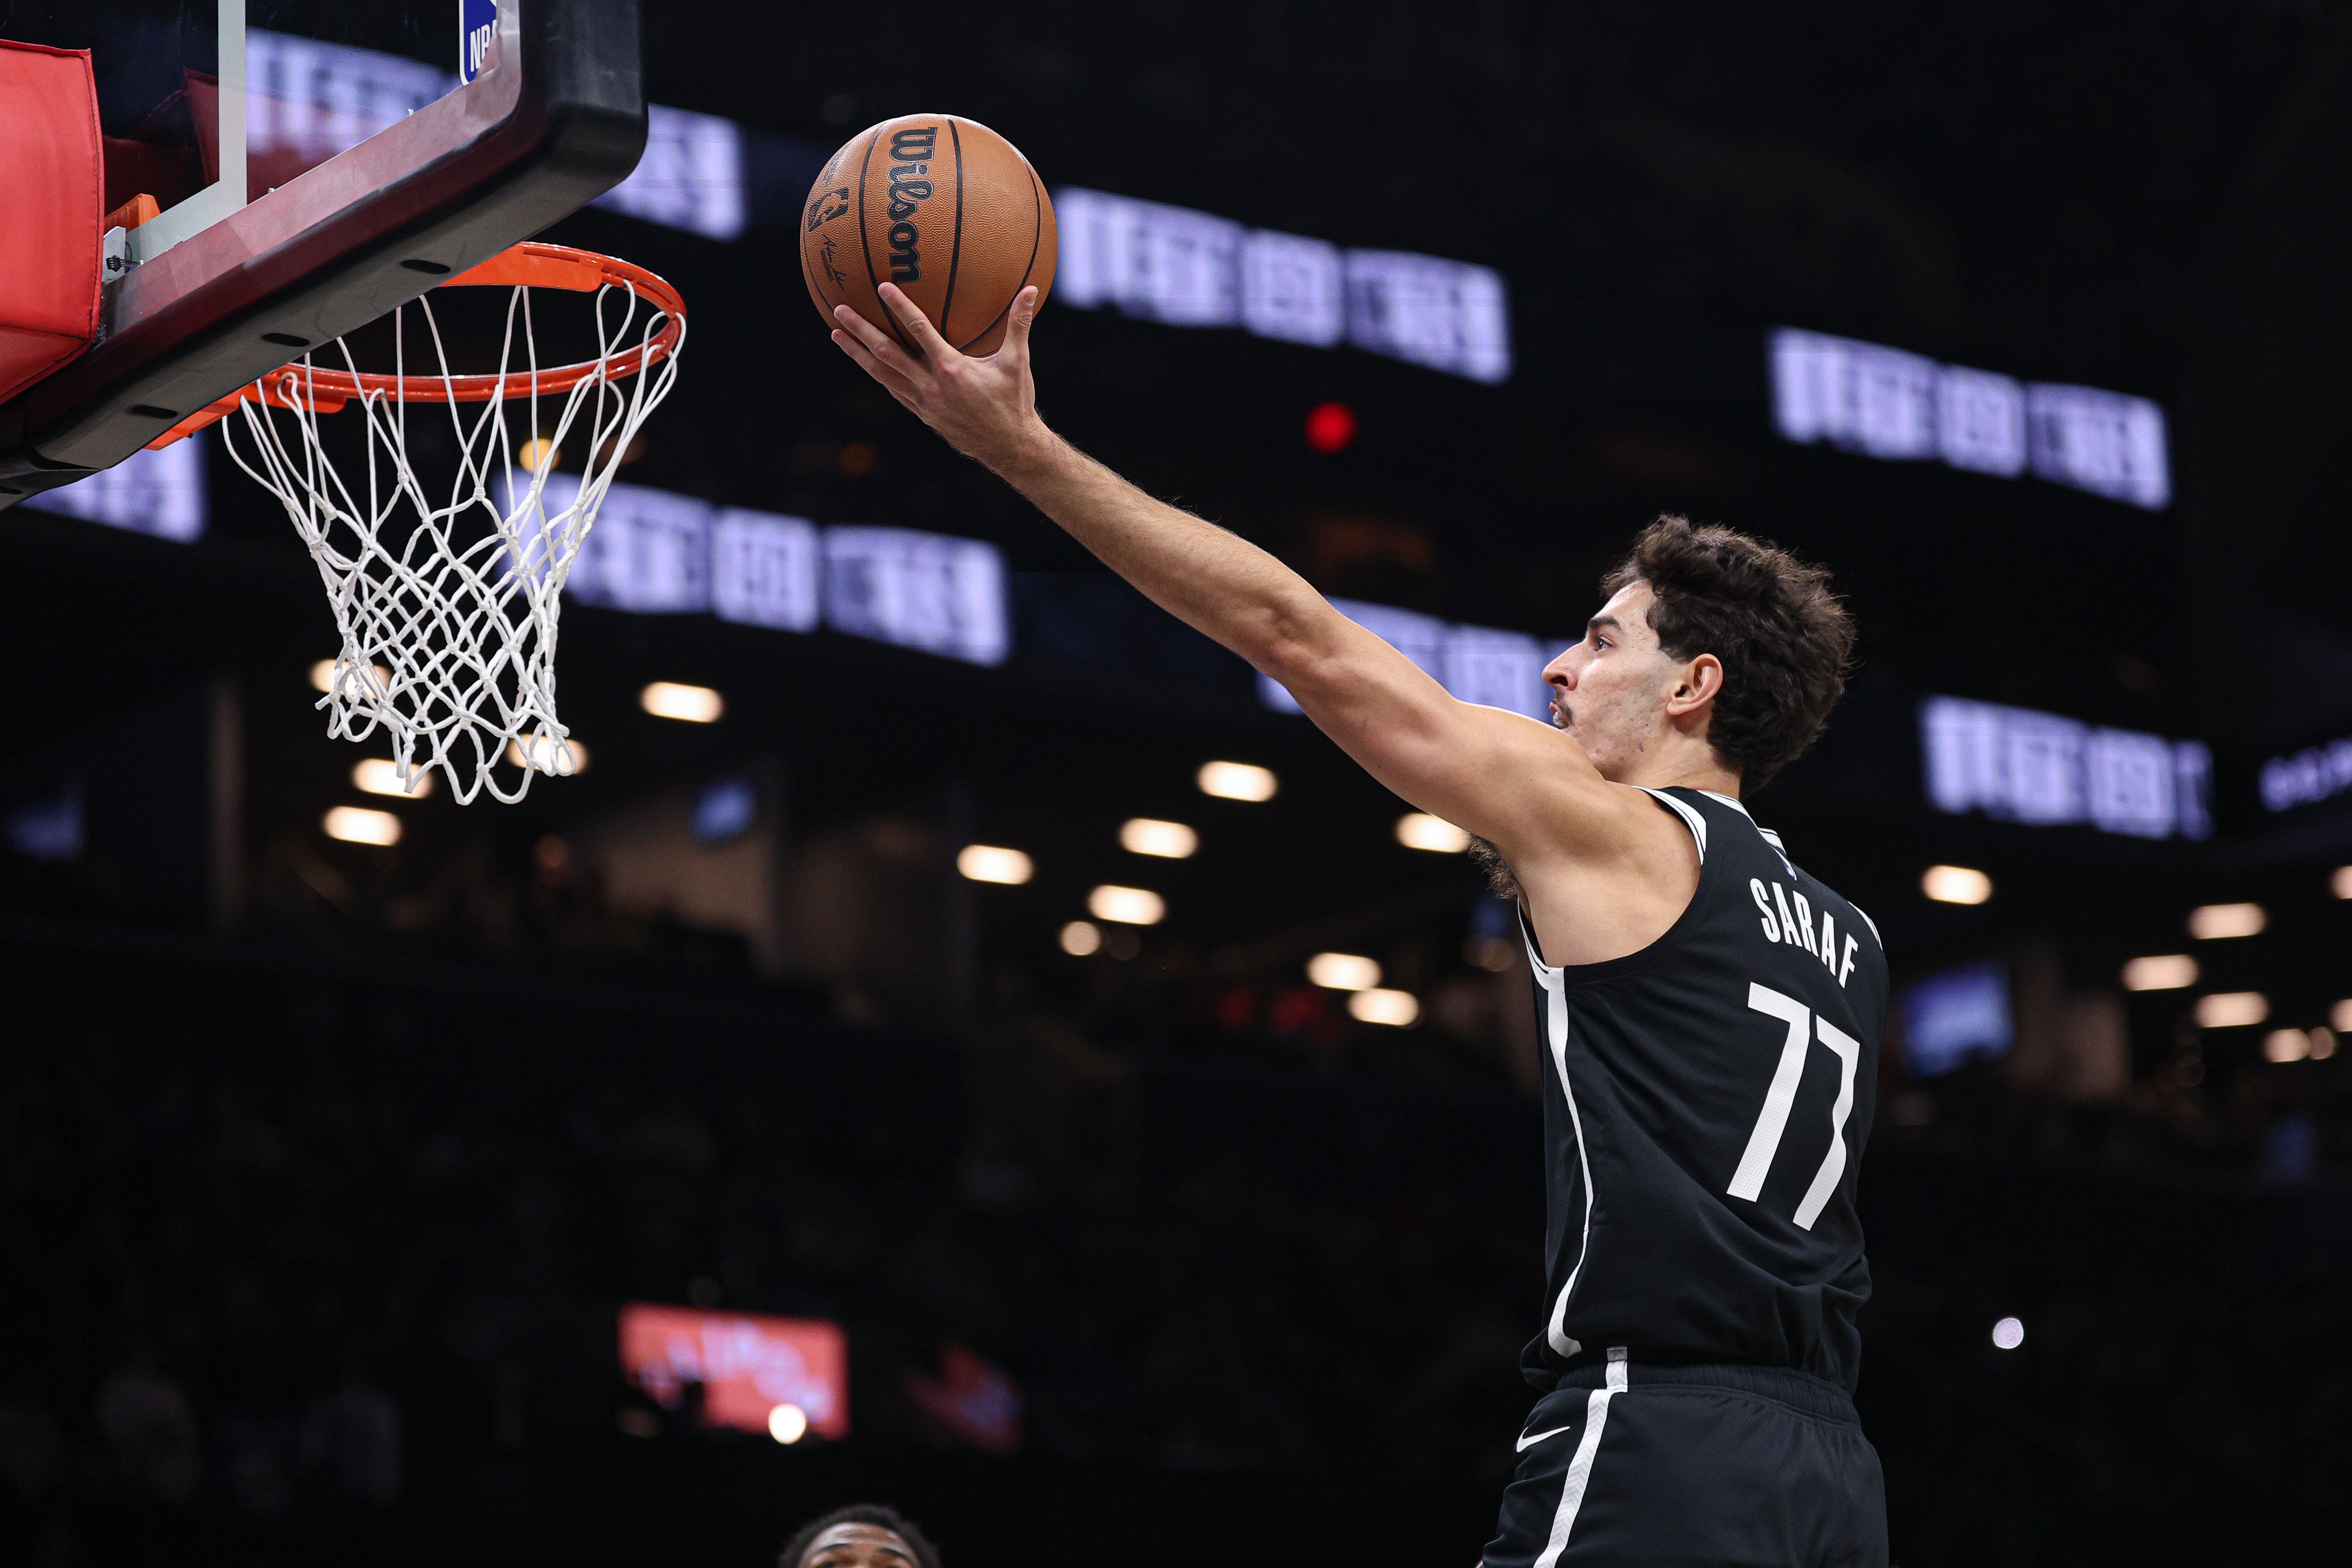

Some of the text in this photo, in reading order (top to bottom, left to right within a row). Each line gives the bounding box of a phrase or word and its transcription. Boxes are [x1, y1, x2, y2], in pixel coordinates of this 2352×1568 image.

[470, 19, 497, 72] NB
[887, 126, 938, 285] Wilson
[1750, 878, 1859, 989] SARAF
[1726, 981, 1860, 1232] 77
